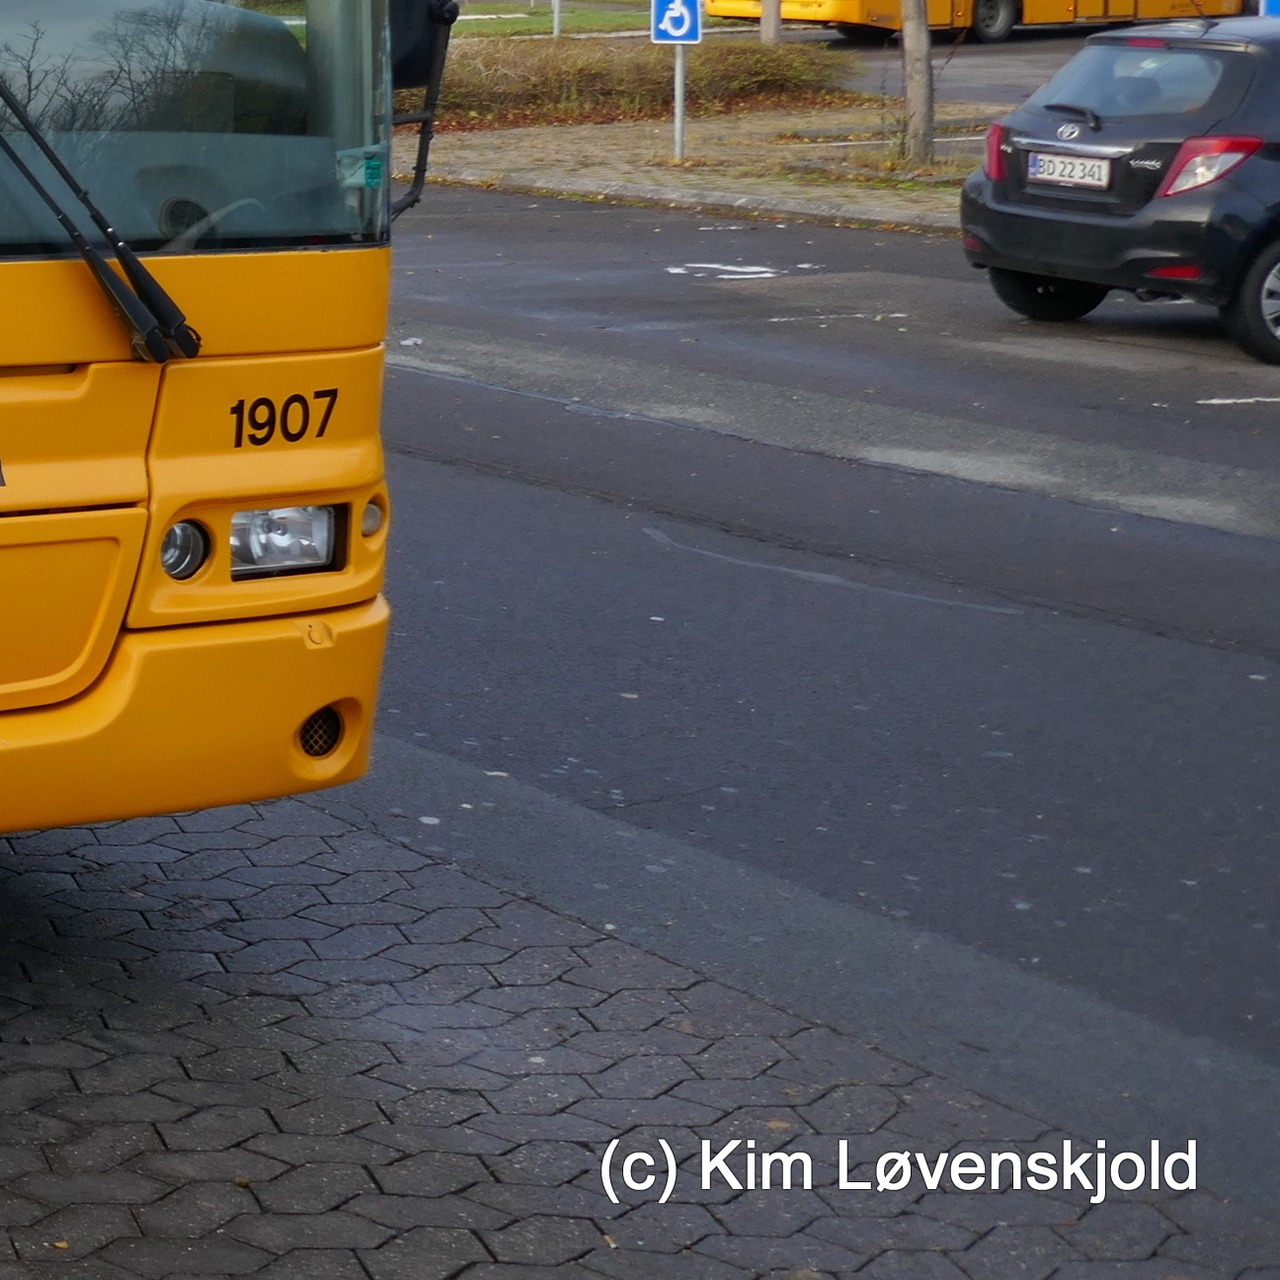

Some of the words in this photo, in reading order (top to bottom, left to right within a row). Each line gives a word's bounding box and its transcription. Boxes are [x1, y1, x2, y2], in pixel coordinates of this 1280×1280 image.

[1038, 159, 1056, 176] BD
[1059, 161, 1075, 179] 22
[1078, 162, 1103, 182] 341
[230, 388, 339, 449] 1907
